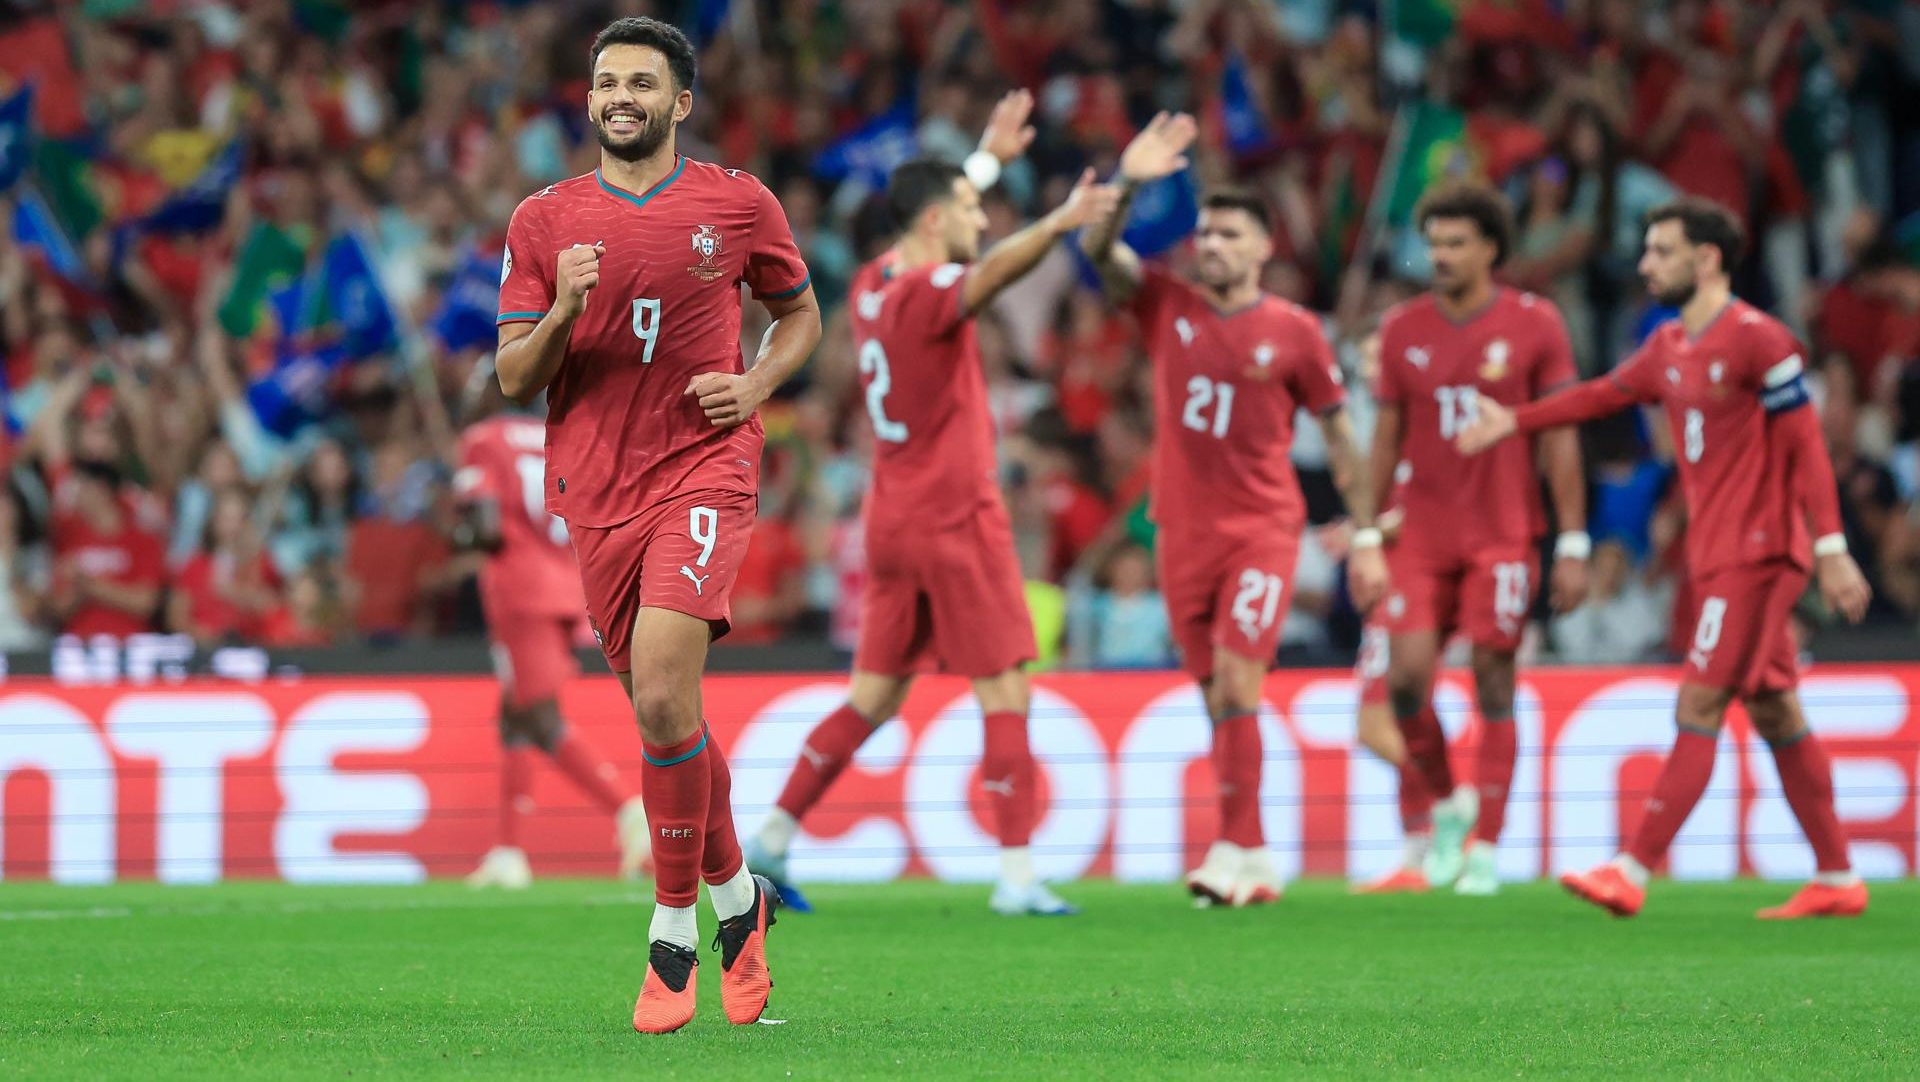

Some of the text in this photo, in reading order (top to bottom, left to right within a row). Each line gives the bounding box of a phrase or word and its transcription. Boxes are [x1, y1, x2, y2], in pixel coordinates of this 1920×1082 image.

[632, 298, 661, 364] 9
[859, 338, 909, 443] 2
[1183, 374, 1235, 439] 21
[1684, 407, 1705, 464] 8
[689, 505, 718, 567] 9
[1231, 568, 1283, 629] 21
[1493, 562, 1529, 617] 13
